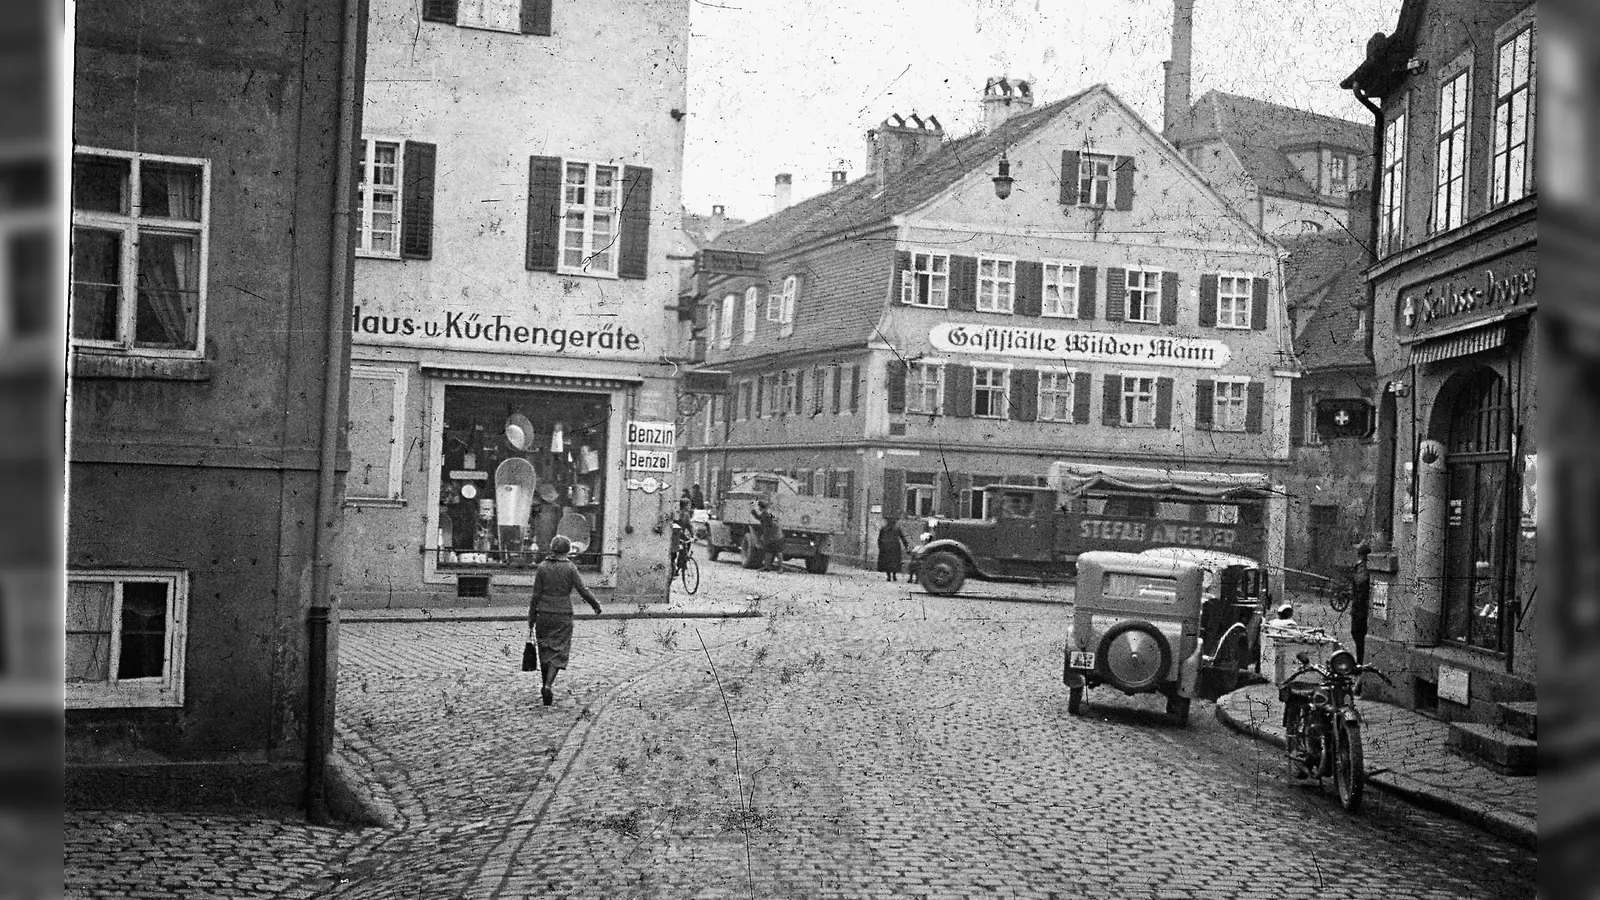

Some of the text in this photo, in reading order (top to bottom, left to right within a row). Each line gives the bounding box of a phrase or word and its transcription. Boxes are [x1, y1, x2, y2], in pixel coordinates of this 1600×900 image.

[445, 311, 640, 352] Küchengeräte
[1065, 333, 1143, 356] Wilder
[1148, 338, 1214, 361] Mann
[628, 423, 673, 445] Benzin
[630, 451, 670, 469] Benzol
